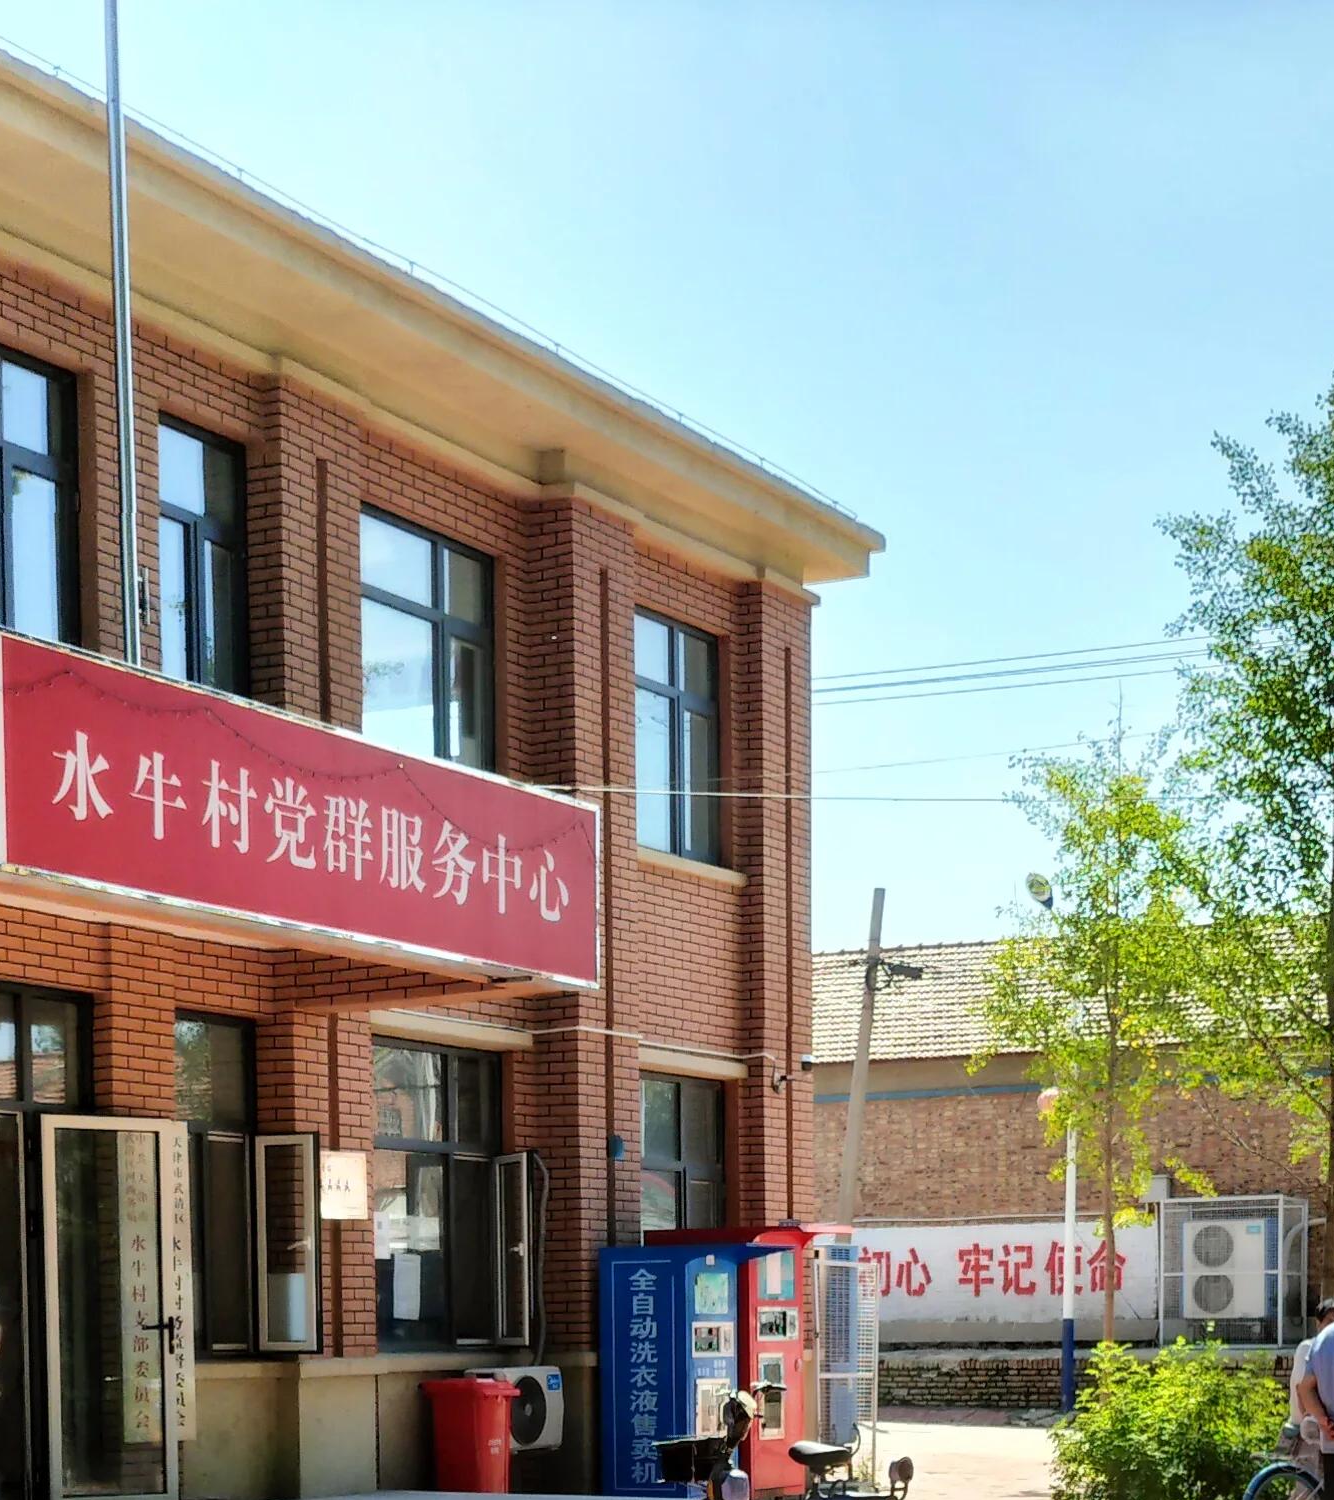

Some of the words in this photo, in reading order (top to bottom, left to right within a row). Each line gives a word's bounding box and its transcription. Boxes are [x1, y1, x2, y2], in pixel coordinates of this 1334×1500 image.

[52, 730, 570, 922] 水牛村党群服务中心
[131, 1235, 149, 1428] 水牛村支部委员会
[958, 1240, 1127, 1297] 牢记使命
[628, 1268, 659, 1484] 全自动洗衣液售卖机
